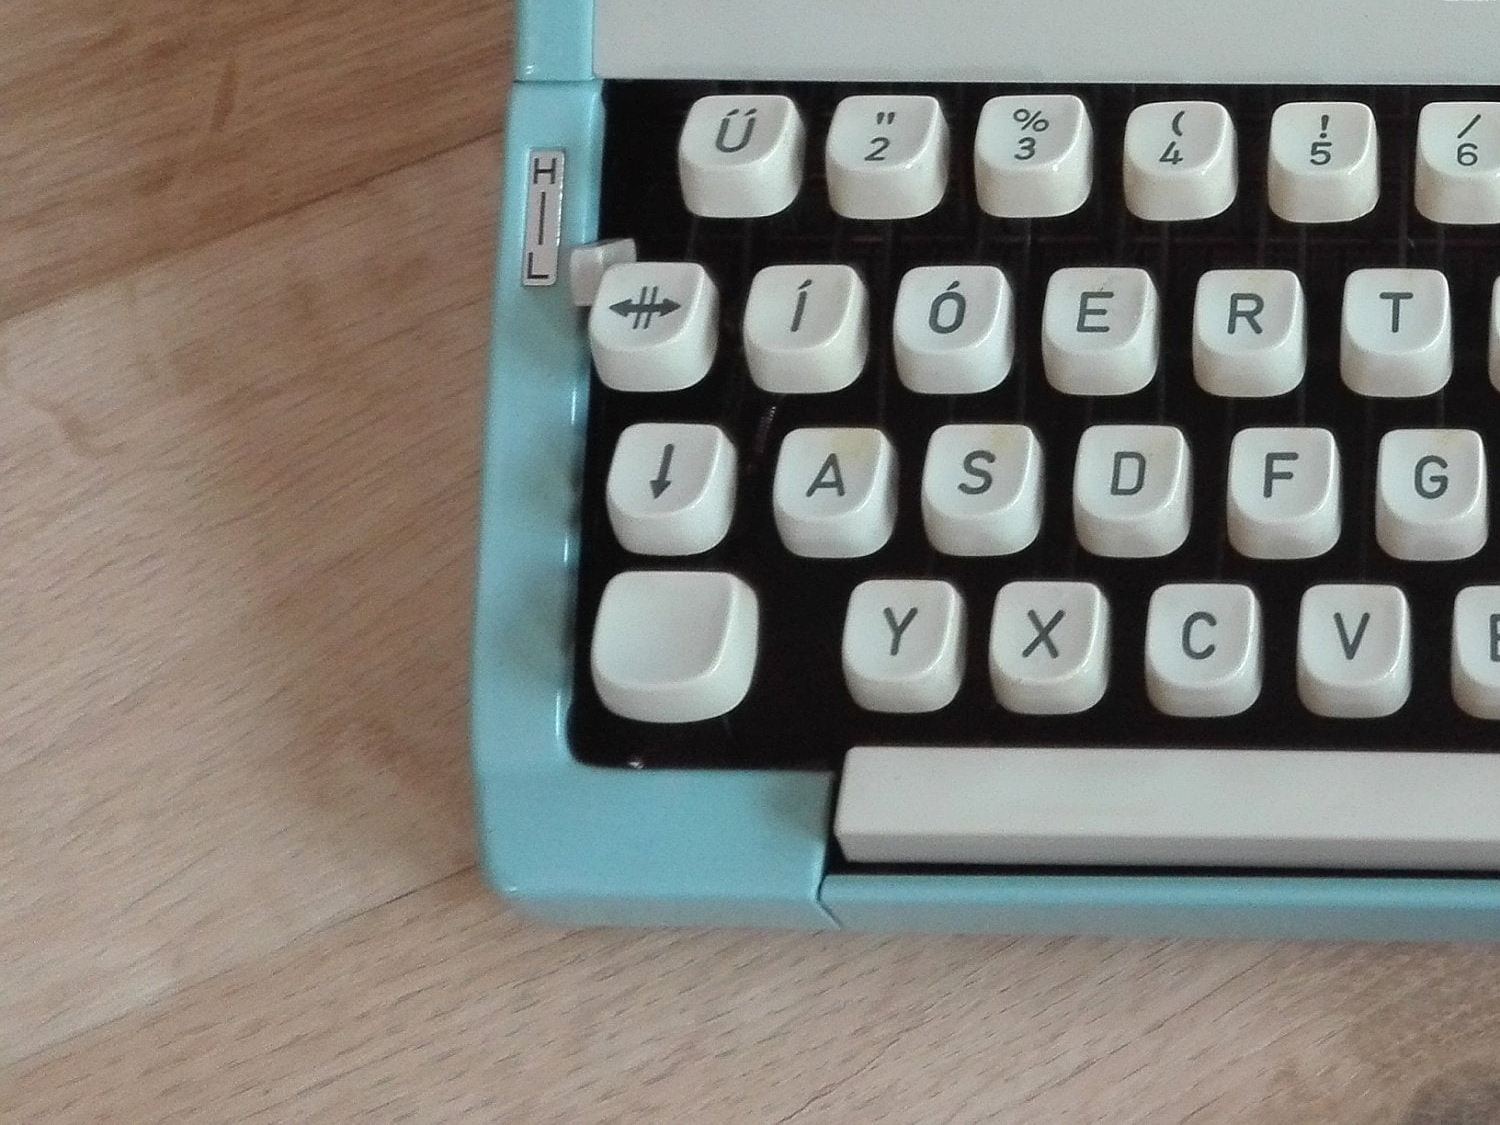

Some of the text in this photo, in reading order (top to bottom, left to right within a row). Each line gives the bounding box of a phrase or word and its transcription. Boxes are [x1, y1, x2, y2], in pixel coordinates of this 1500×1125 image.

[715, 107, 758, 153] Ű
[1013, 108, 1050, 133] %
[1171, 110, 1186, 137] (
[1319, 114, 1330, 139] !
[864, 136, 891, 162] 2
[1014, 136, 1037, 161] 3
[1158, 140, 1184, 165] 4
[1310, 141, 1333, 166] 5
[1456, 142, 1478, 167] 6
[533, 157, 557, 185] H
[526, 251, 549, 280] L
[790, 279, 813, 333] Í
[928, 280, 967, 335] Ó
[1076, 291, 1115, 333] E
[1227, 292, 1265, 335] R
[1379, 291, 1414, 334] T
[805, 452, 846, 498] A
[957, 449, 996, 495] S
[1110, 451, 1147, 496] D
[1263, 451, 1299, 499] F
[1414, 454, 1449, 500] G
[883, 607, 919, 656] Y
[1022, 609, 1066, 659] X
[1181, 611, 1218, 660] C
[1333, 612, 1371, 661] V
